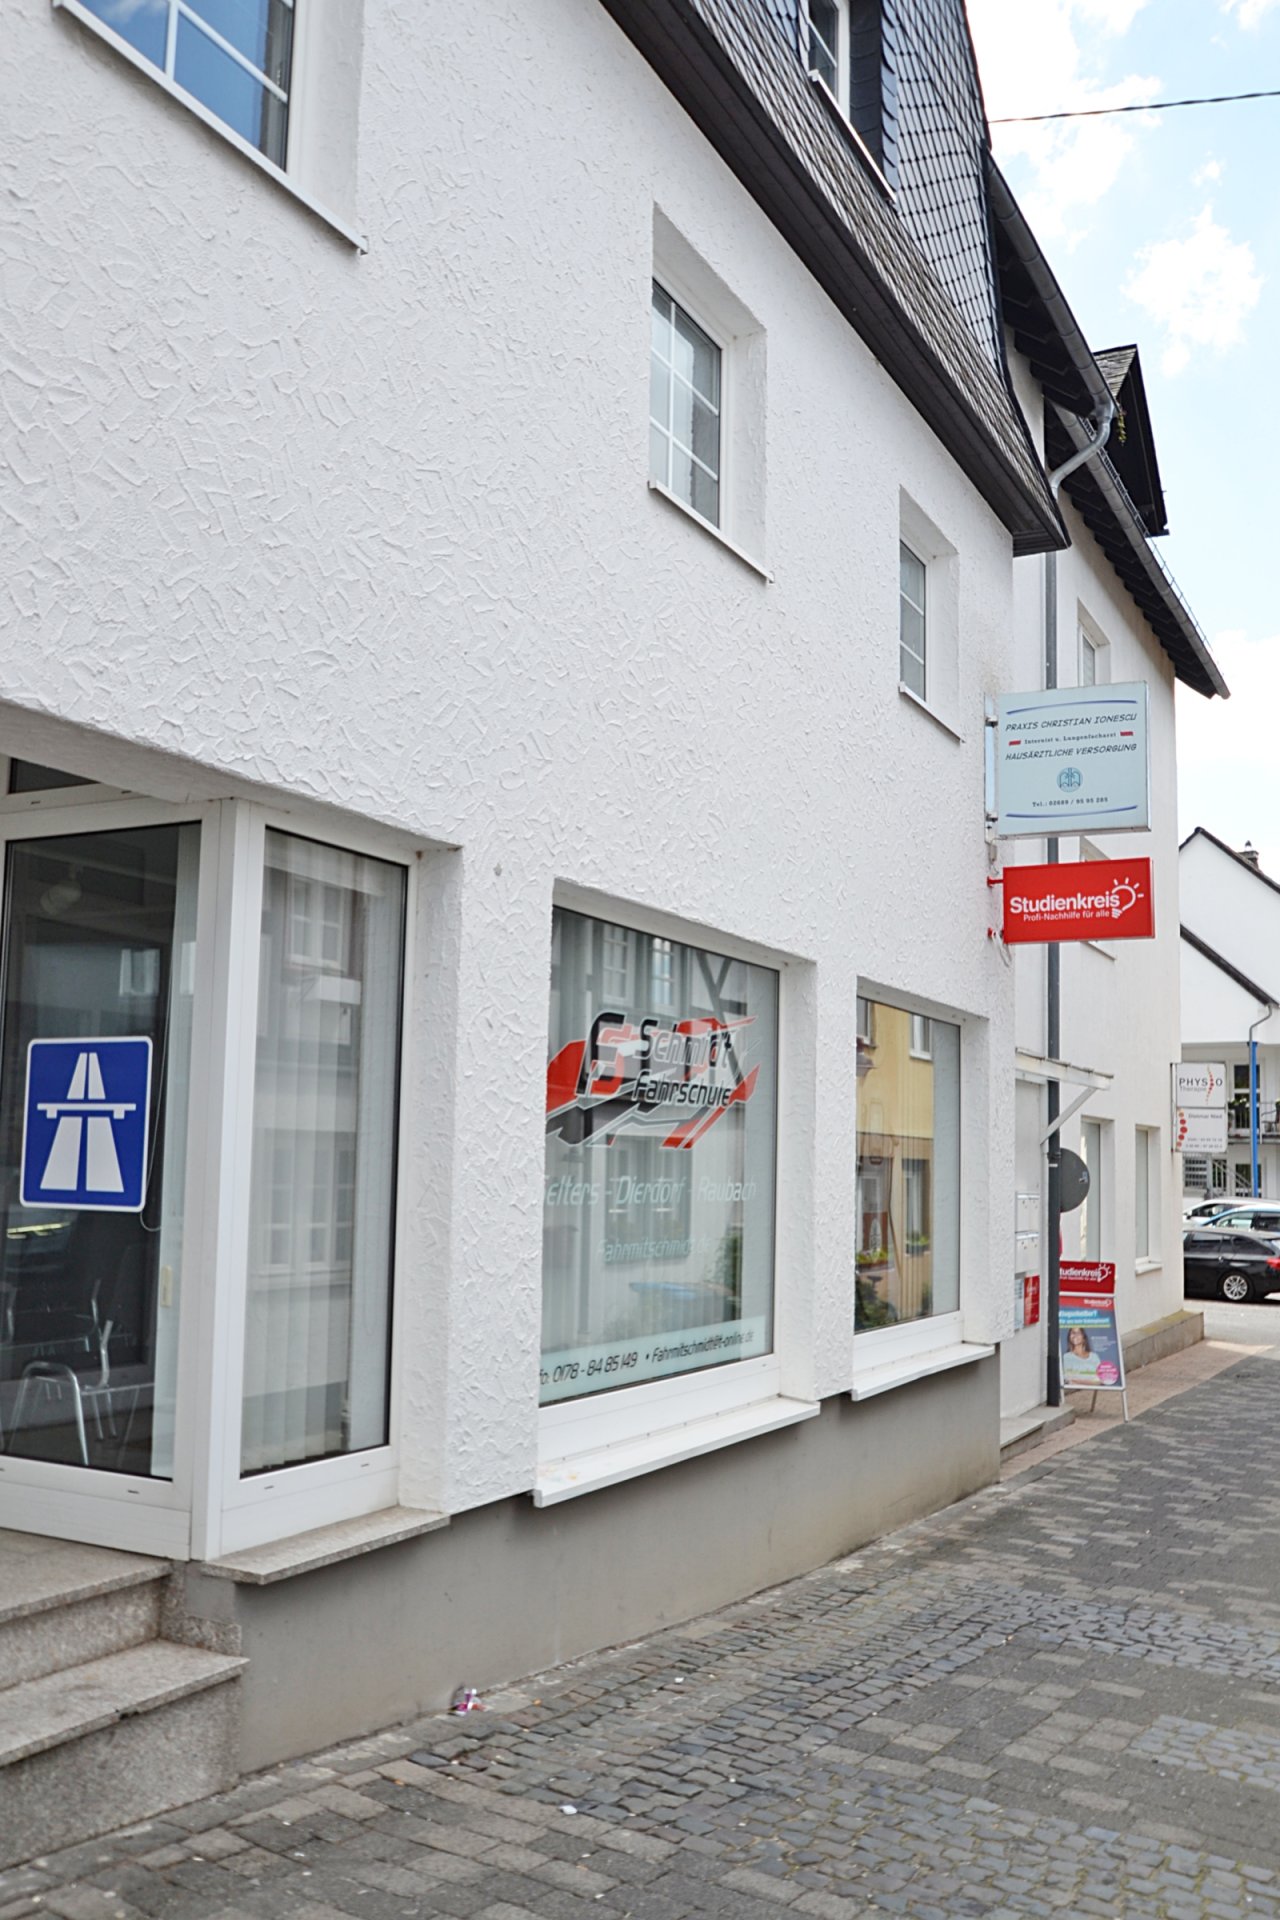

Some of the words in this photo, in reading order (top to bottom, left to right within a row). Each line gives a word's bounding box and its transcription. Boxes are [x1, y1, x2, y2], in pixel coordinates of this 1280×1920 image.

[1005, 721, 1038, 731] PRAXIS
[1041, 717, 1092, 728] CHRISTIAN
[1094, 713, 1137, 724] IONESCU
[1024, 737, 1054, 745] Internist
[1005, 748, 1073, 761] HAUSÄRZTLICHE
[1076, 743, 1137, 755] VERSORGUNG
[1010, 890, 1120, 914] Studienkreis
[1023, 911, 1080, 922] Profi-Nachhilfe
[1082, 910, 1094, 919] für
[1095, 909, 1110, 918] alle
[633, 1017, 737, 1069] Schmidt
[631, 1069, 732, 1108] Fahrschule
[543, 1174, 600, 1205] elters
[614, 1175, 687, 1205] Dierdorf
[698, 1175, 757, 1202] Raubach
[1059, 1267, 1102, 1277] tudienkreis
[553, 1362, 580, 1383] 0178
[587, 1358, 603, 1376] 84
[604, 1354, 620, 1373] 85
[621, 1350, 639, 1370] 149
